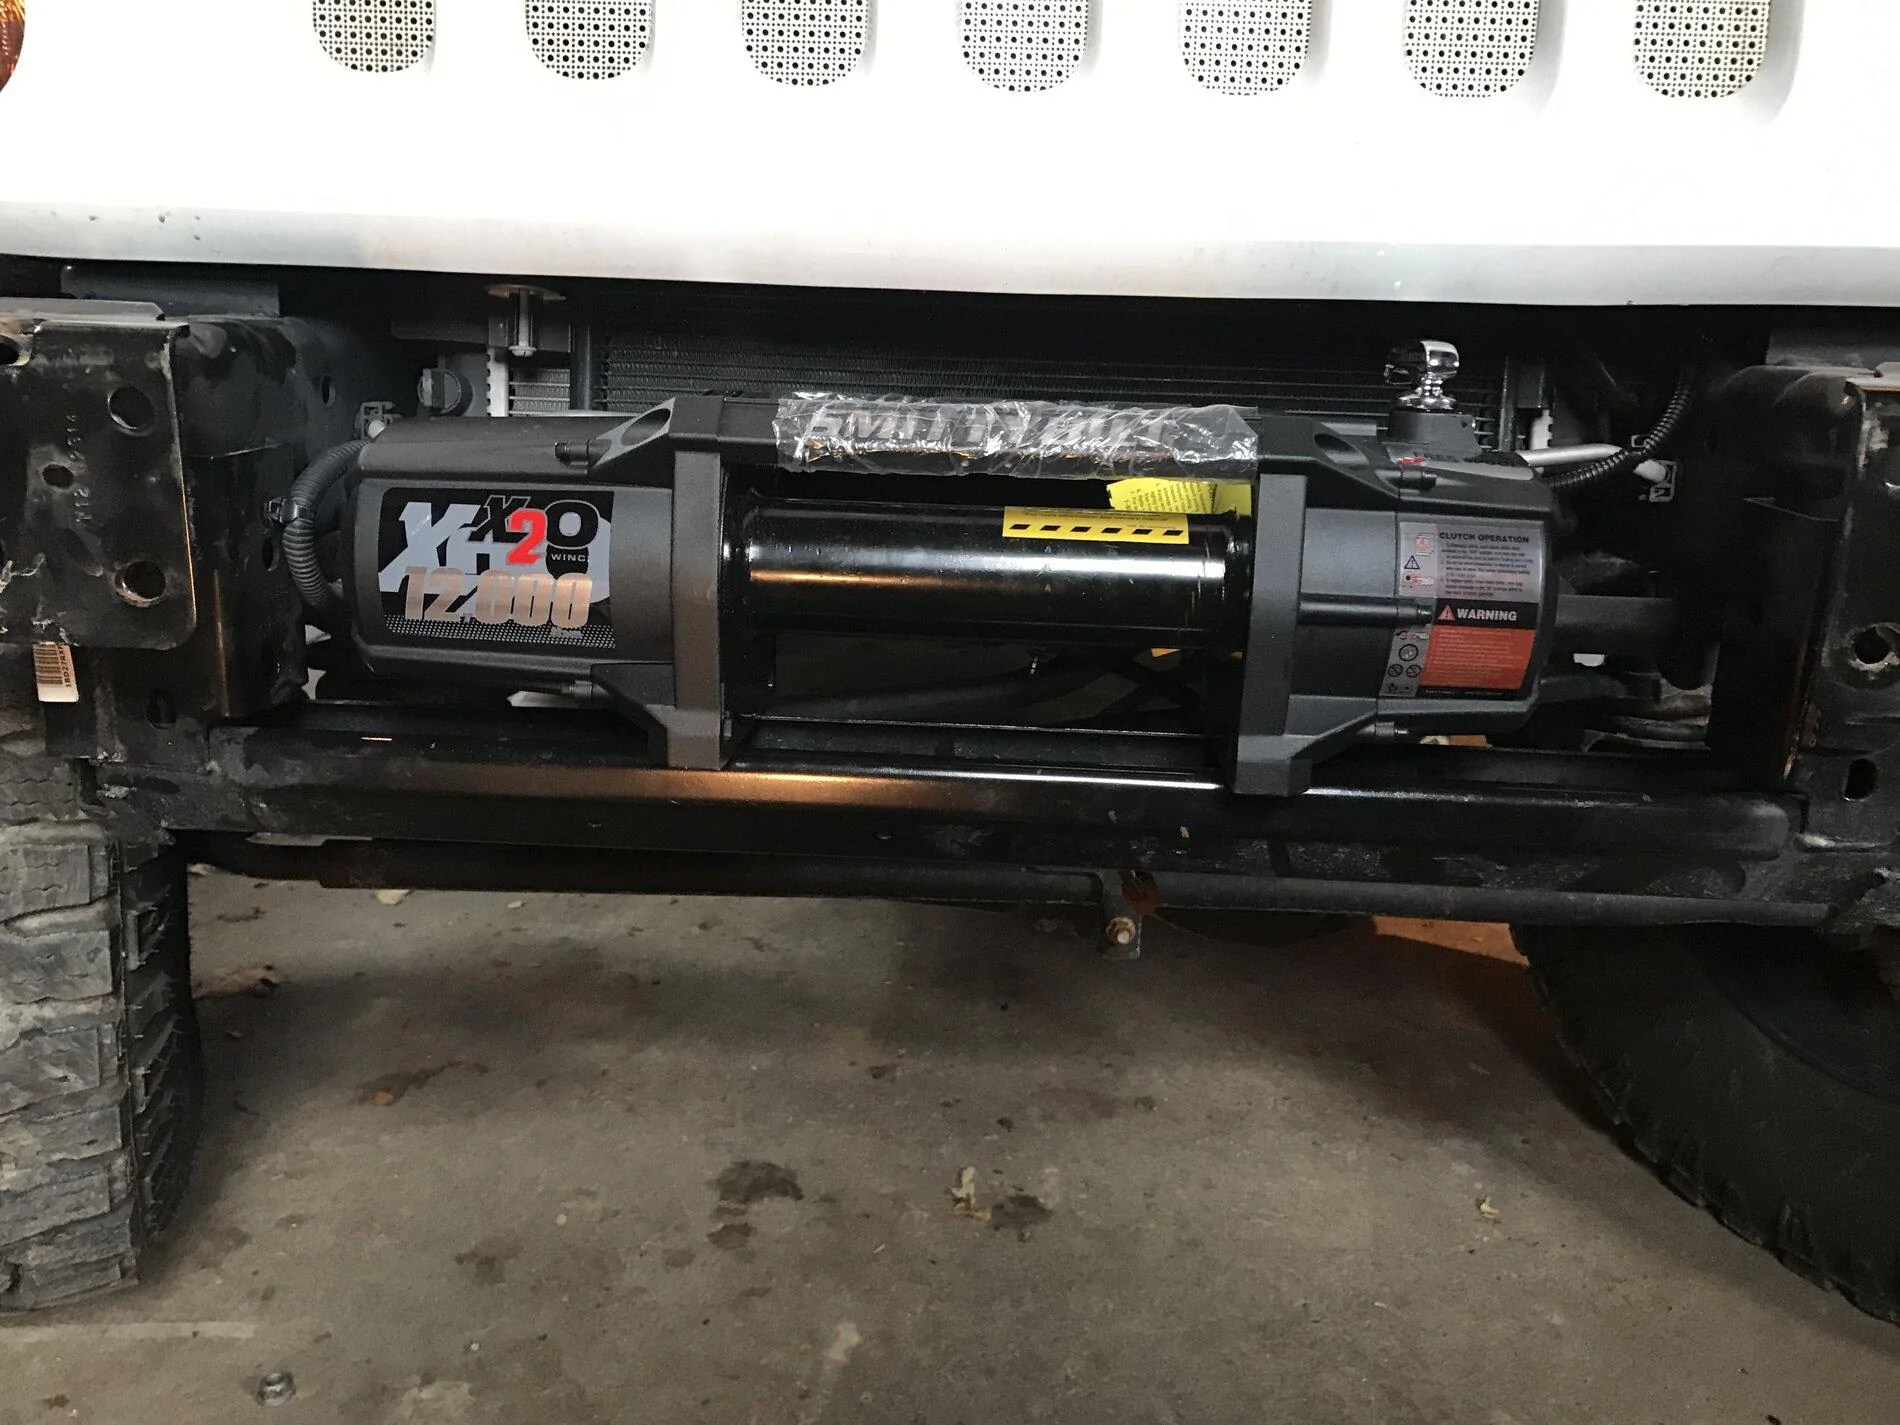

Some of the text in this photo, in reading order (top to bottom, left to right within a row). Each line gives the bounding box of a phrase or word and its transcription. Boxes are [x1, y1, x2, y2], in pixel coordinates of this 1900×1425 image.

[1439, 532, 1530, 544] CLUTCH OPERATION
[551, 552, 588, 562] WINC
[1457, 608, 1518, 621] WARNING
